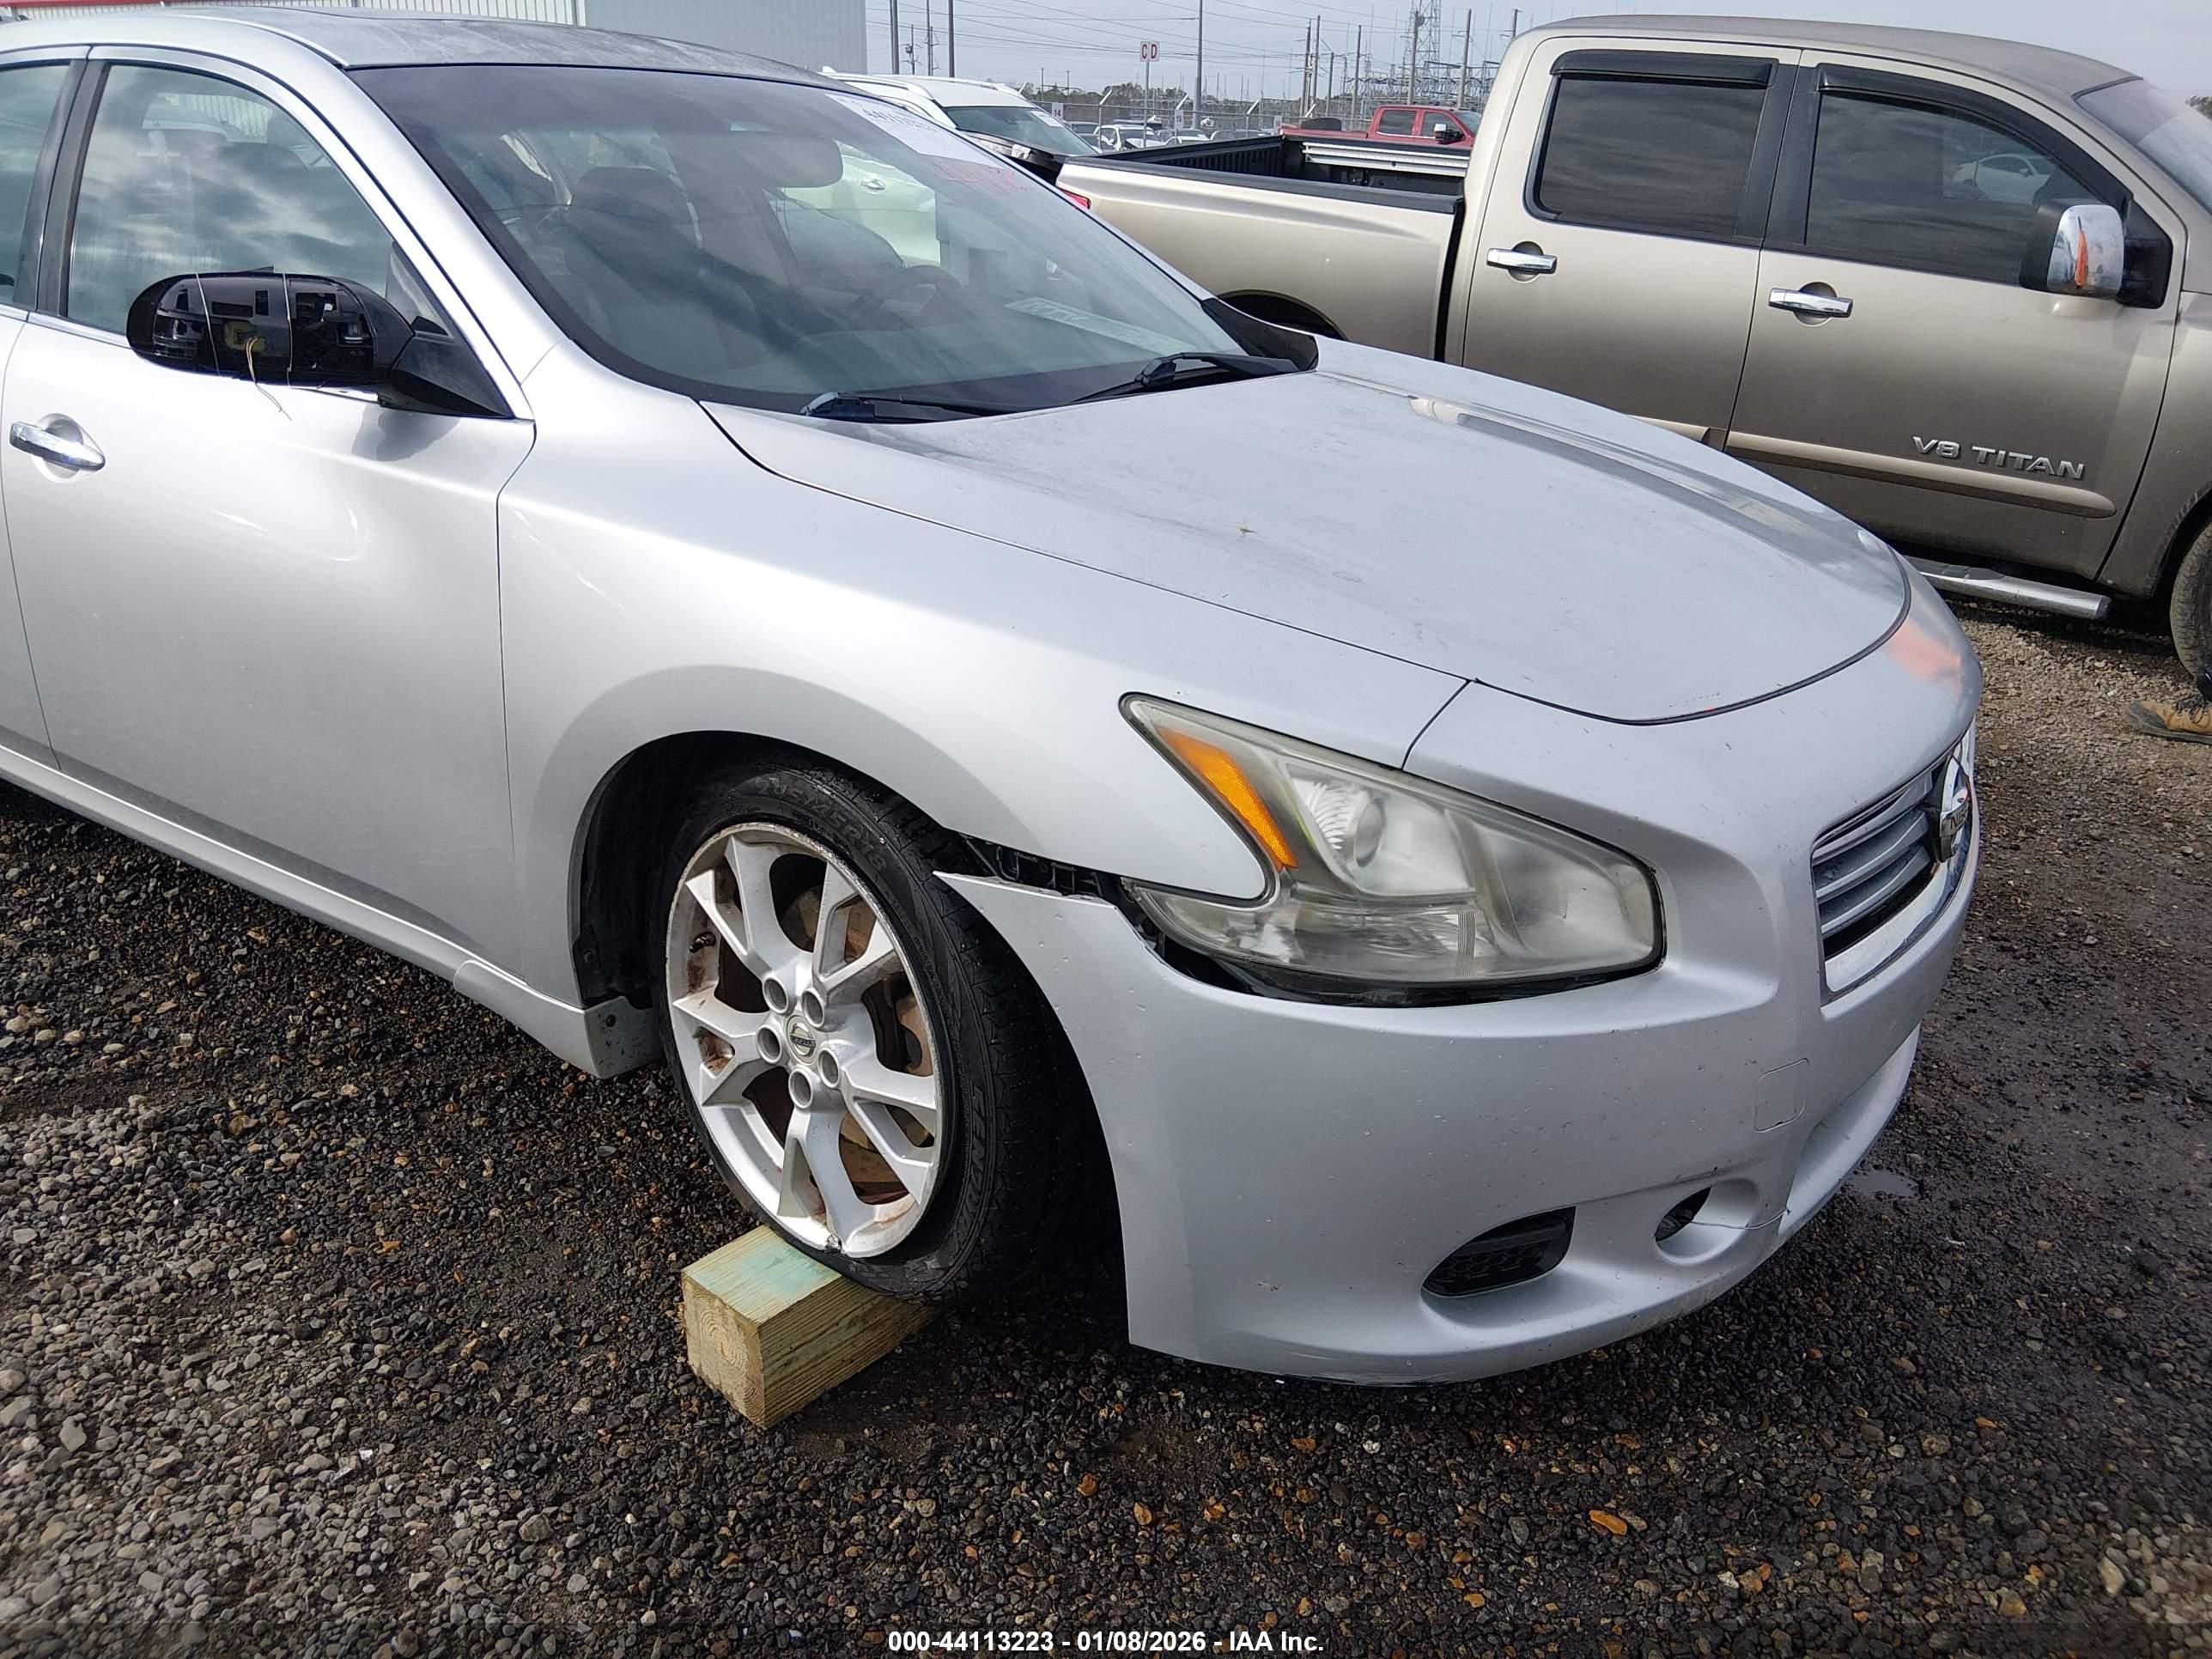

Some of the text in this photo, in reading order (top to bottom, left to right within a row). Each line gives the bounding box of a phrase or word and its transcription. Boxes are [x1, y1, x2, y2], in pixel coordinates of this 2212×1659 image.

[1142, 44, 1158, 59] C D
[1912, 435, 2085, 480] V8 TITAN
